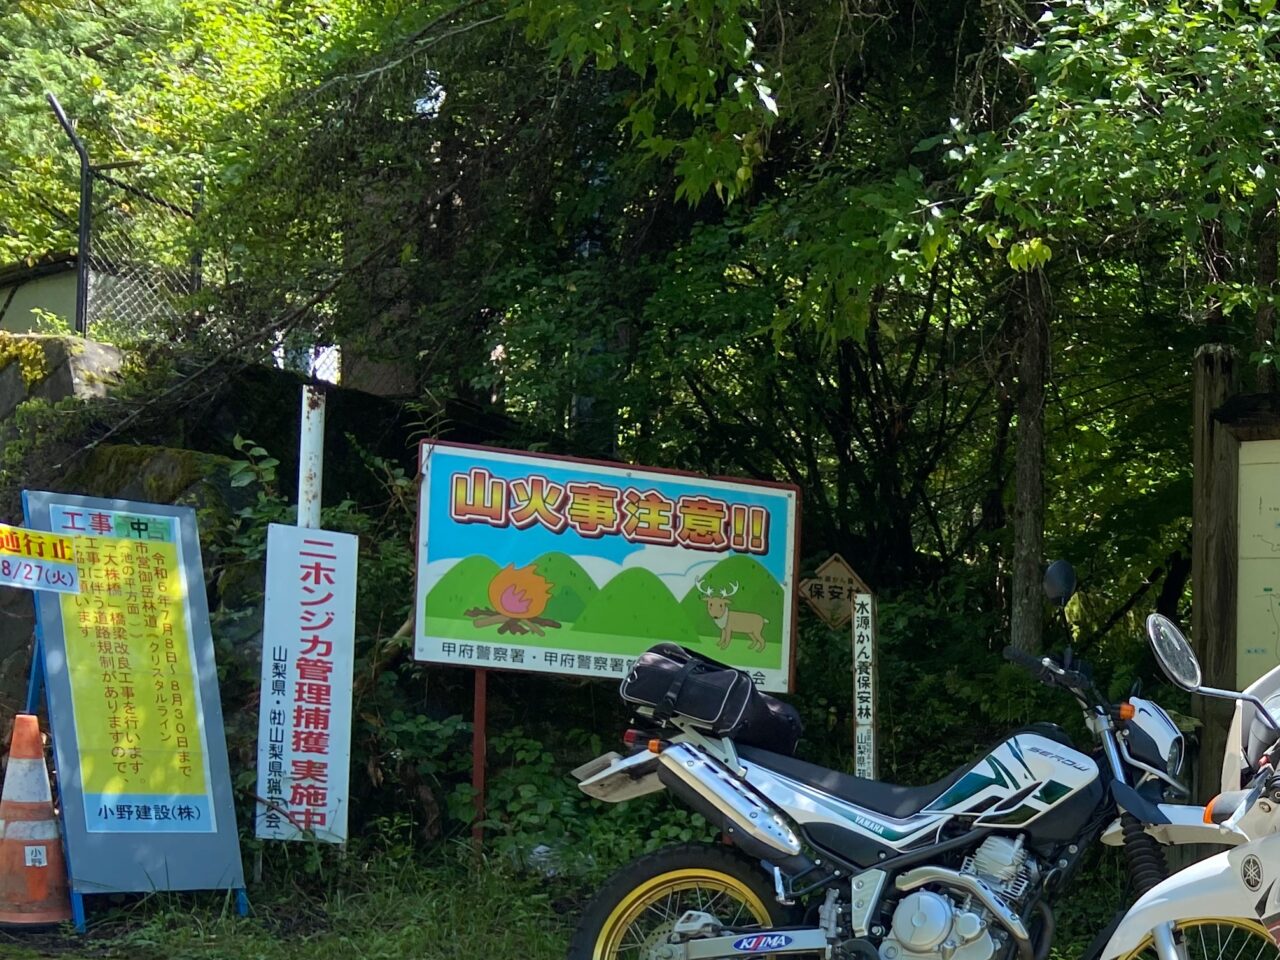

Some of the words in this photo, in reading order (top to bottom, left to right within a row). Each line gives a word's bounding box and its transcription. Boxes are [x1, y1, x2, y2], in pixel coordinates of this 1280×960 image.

[61, 511, 113, 535] 工事
[449, 467, 771, 556] 山火事注意!!
[856, 600, 872, 720] 水源かん養保安林
[1028, 746, 1091, 772] SEROW
[98, 804, 201, 821] 小野建設(株)
[854, 815, 885, 834] YAMAHA
